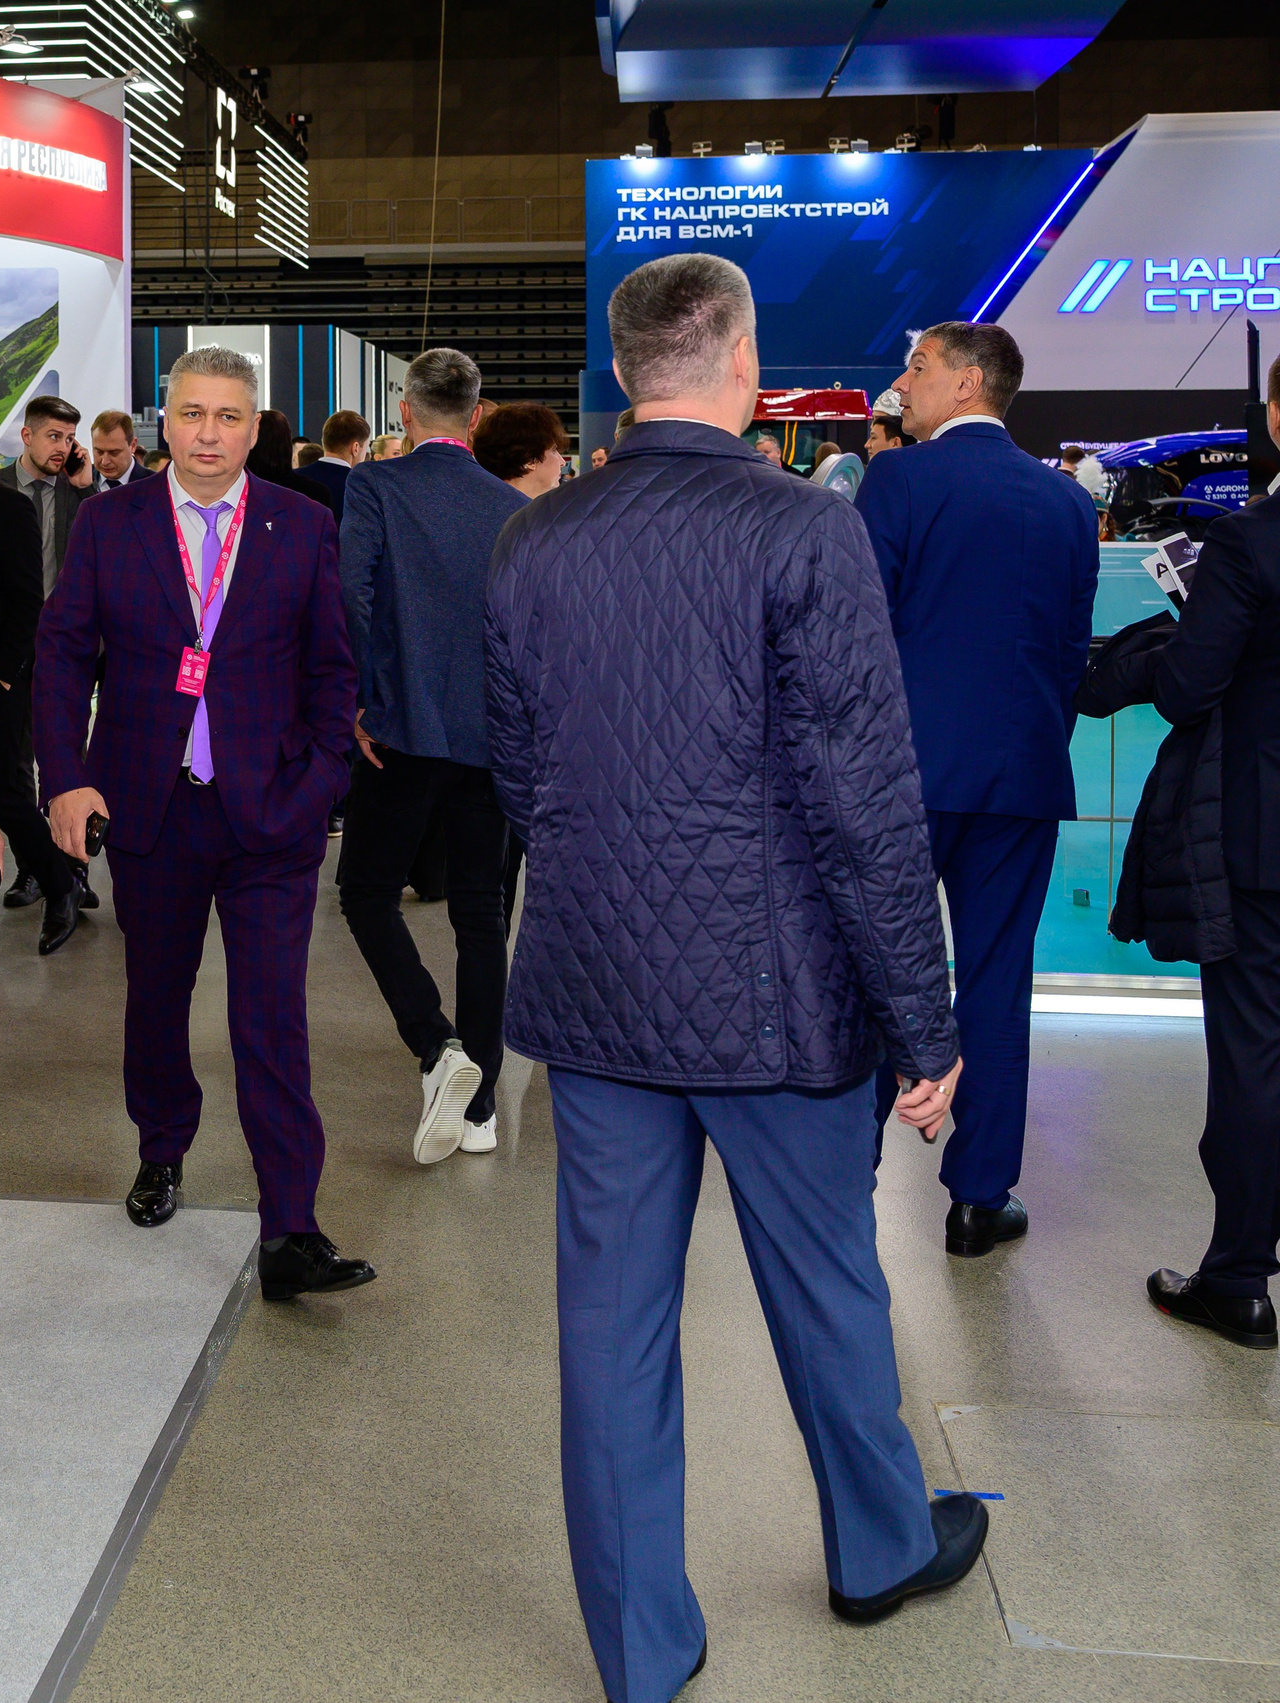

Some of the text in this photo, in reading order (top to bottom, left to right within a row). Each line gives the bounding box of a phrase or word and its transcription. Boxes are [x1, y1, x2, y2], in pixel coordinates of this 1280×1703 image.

[11, 139, 108, 191] РЕСПУБЛИКА
[616, 185, 783, 202] ТЕХНОЛОГИИ
[618, 198, 889, 222] ГК НАЦПРОЕКТСТРОЙ
[616, 224, 753, 242] ДЛЯ ВСМ-1
[1145, 288, 1280, 312] СТРО
